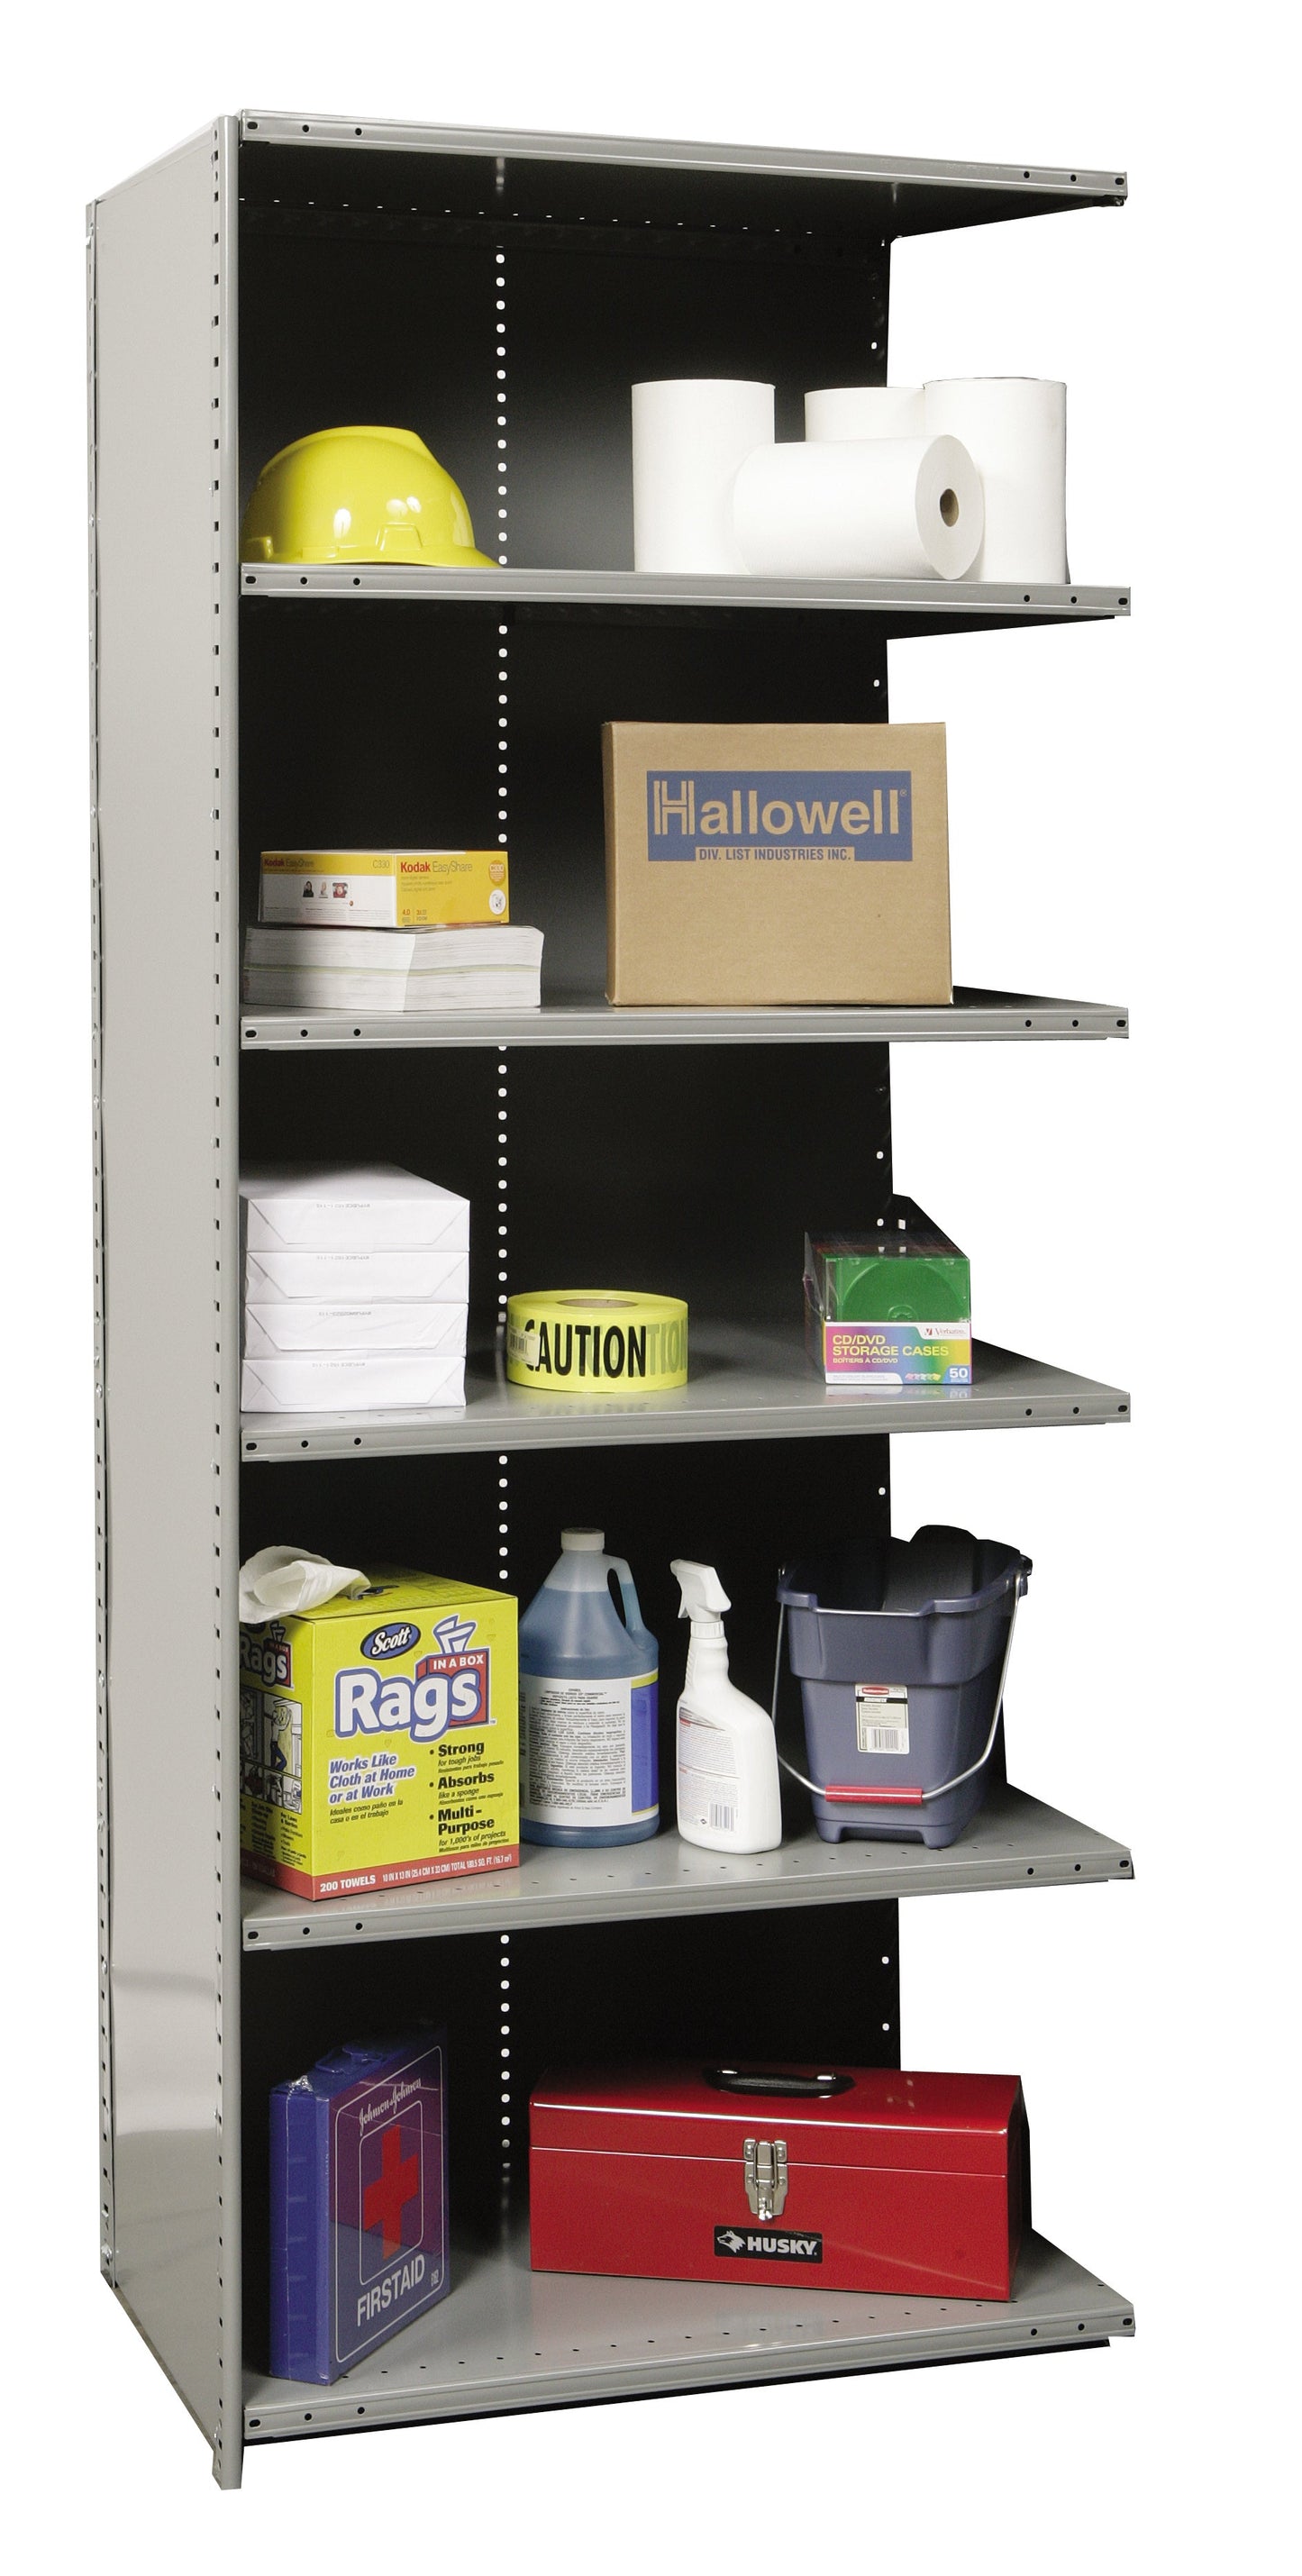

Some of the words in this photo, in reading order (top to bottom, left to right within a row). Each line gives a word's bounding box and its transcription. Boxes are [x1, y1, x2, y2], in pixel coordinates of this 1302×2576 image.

[699, 848, 722, 860] DIV.
[725, 848, 751, 860] LIST
[754, 848, 824, 860] INDUSTRIES
[827, 848, 851, 860] INC.
[264, 859, 285, 867] Kodak
[372, 860, 389, 869] C330
[400, 861, 431, 873] Kodak
[432, 860, 473, 875] EasyShare
[833, 1334, 886, 1345] CD/DVD
[833, 1345, 899, 1356] STORAGE
[902, 1345, 949, 1356] CASES
[949, 1368, 969, 1379] 50
[371, 1625, 411, 1654] Scott
[432, 1657, 447, 1670] IN
[449, 1656, 457, 1667] A
[460, 1654, 484, 1666] BOX
[338, 1670, 479, 1739] Rags
[438, 1743, 485, 1757] Strong
[330, 1758, 369, 1774] Works
[371, 1753, 397, 1768] Like
[438, 1759, 447, 1767] for
[449, 1756, 467, 1766] tough
[467, 1755, 481, 1764] jobs
[330, 1772, 361, 1789] Cloth
[364, 1771, 378, 1783] at
[379, 1767, 415, 1781] Home
[438, 1771, 495, 1789] Absorbs
[329, 1792, 343, 1804] or
[346, 1789, 359, 1801] at
[361, 1782, 394, 1799] Work
[438, 1791, 450, 1799] like
[457, 1788, 479, 1798] sponge
[330, 1807, 352, 1816] Ideales
[353, 1804, 370, 1813] como
[330, 1816, 344, 1825] casa
[368, 1809, 389, 1818] trabajo
[438, 1818, 495, 1835] Purpose
[473, 1834, 479, 1842] of
[480, 1831, 506, 1842] projects
[451, 1861, 467, 1871] TOTAL
[320, 1880, 339, 1892] 200
[340, 1874, 376, 1889] TOWELS
